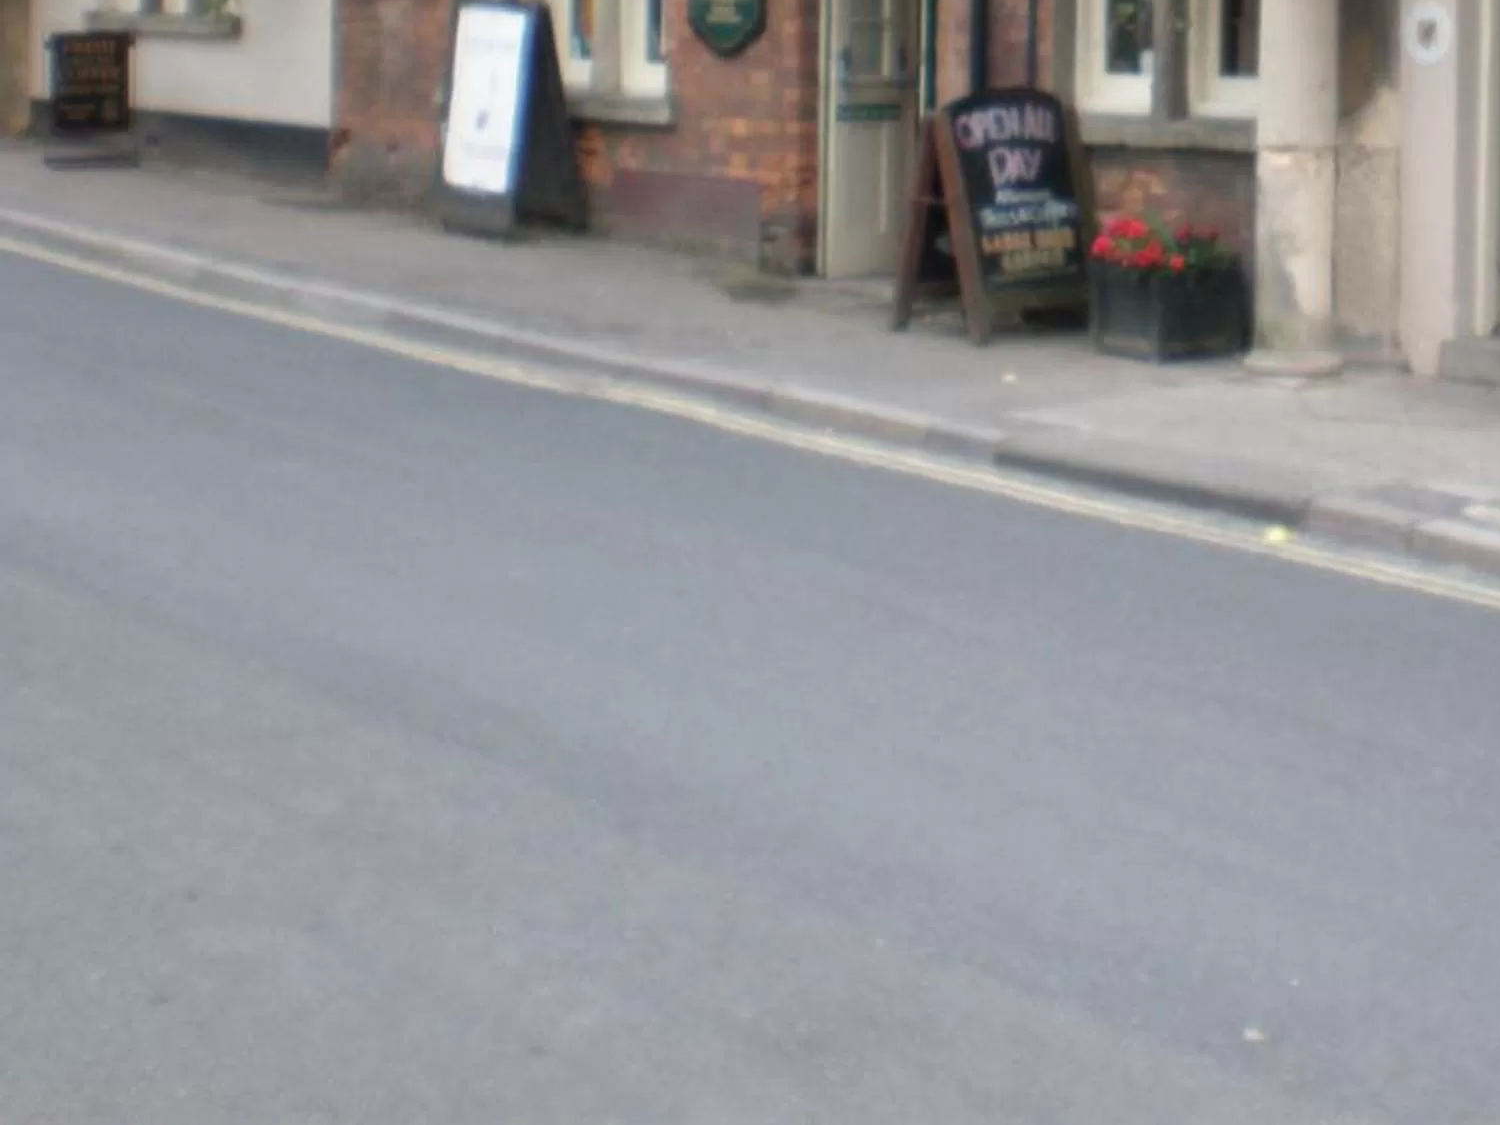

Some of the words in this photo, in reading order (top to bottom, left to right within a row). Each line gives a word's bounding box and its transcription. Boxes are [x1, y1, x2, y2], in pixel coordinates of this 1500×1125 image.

[957, 107, 1020, 148] OPEN
[1025, 103, 1056, 143] ALL
[987, 145, 1042, 186] DAY
